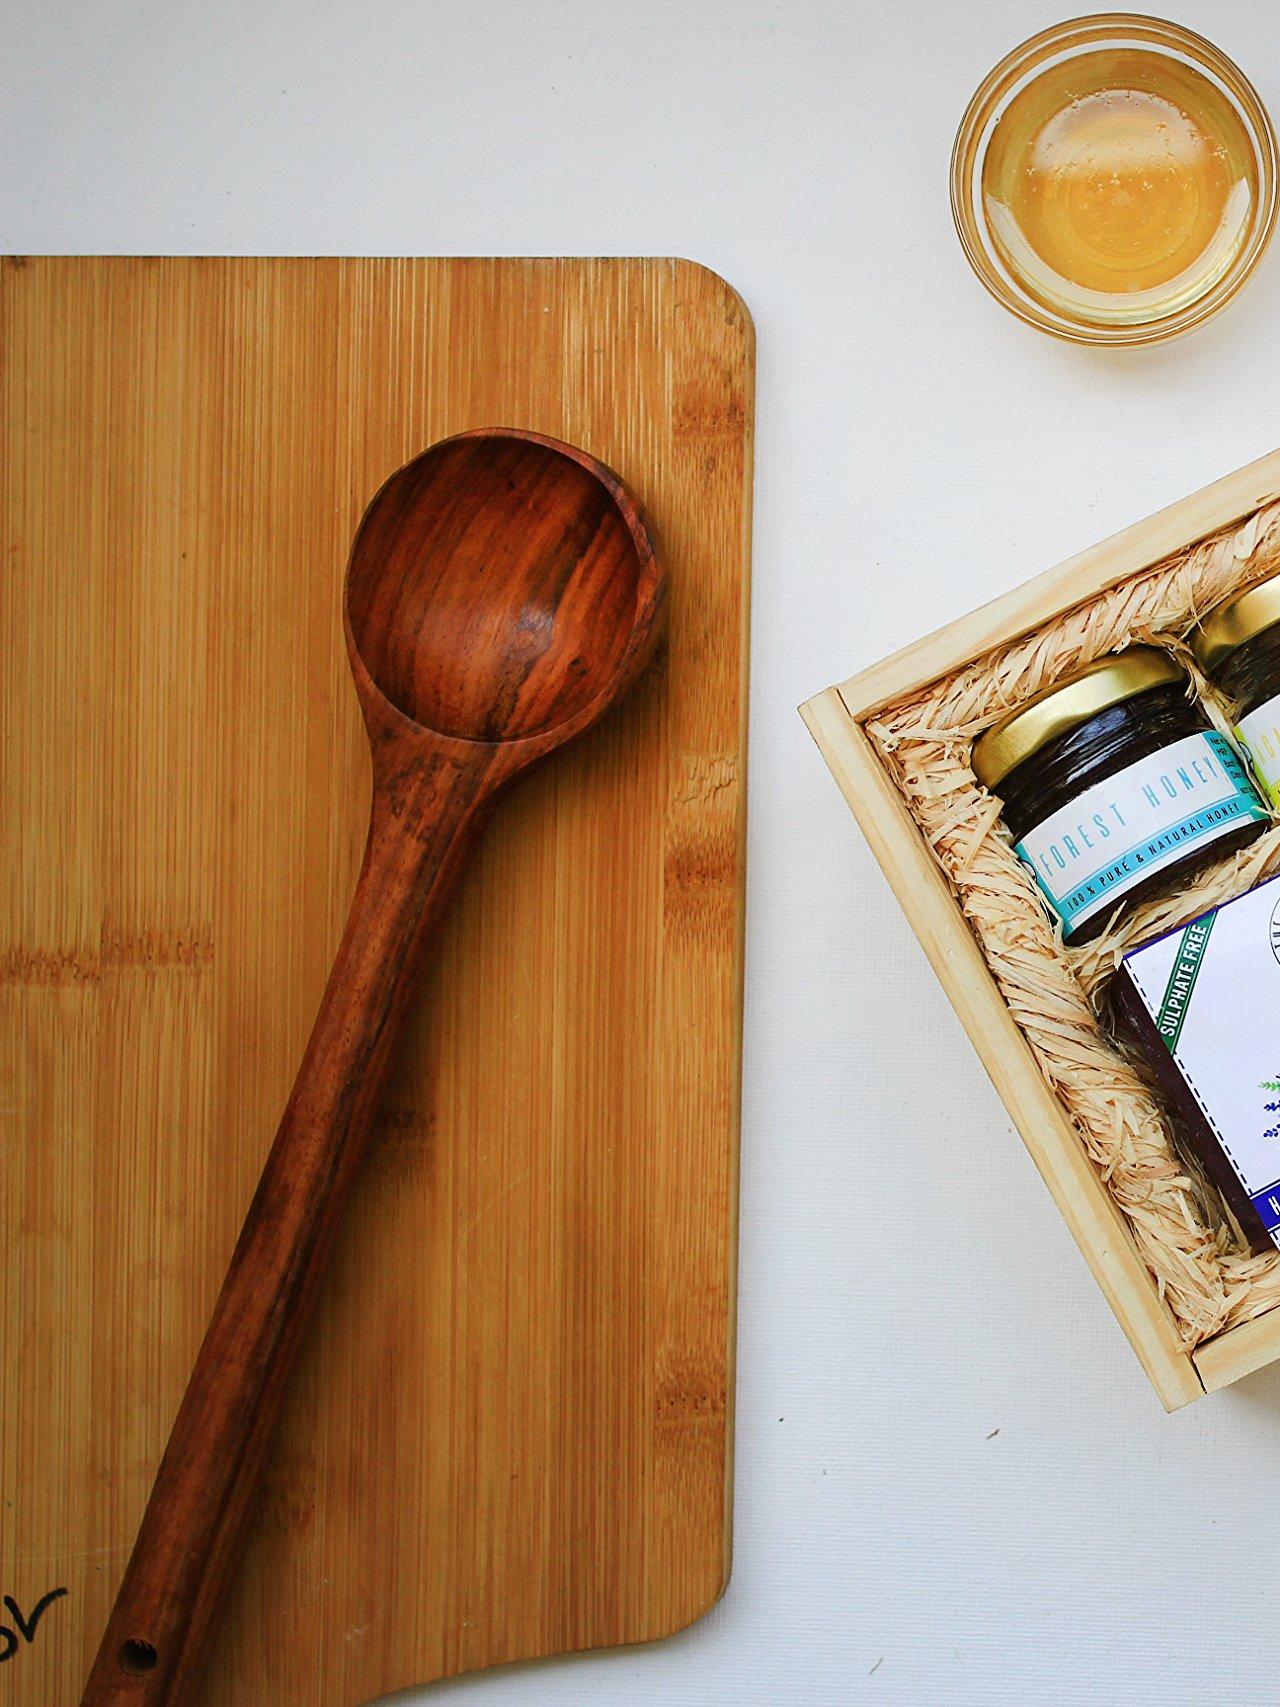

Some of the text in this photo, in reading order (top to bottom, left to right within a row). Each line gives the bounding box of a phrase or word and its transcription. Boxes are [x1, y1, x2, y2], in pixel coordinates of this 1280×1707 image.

[1039, 756, 1219, 877] FOREST HONEY
[1067, 892, 1086, 911] 100
[1099, 861, 1131, 887] PURE
[1135, 853, 1145, 864] &
[1148, 819, 1204, 856] NATURAL
[1206, 802, 1240, 824] HONEY
[1160, 924, 1207, 1037] SULPHATE FREE
